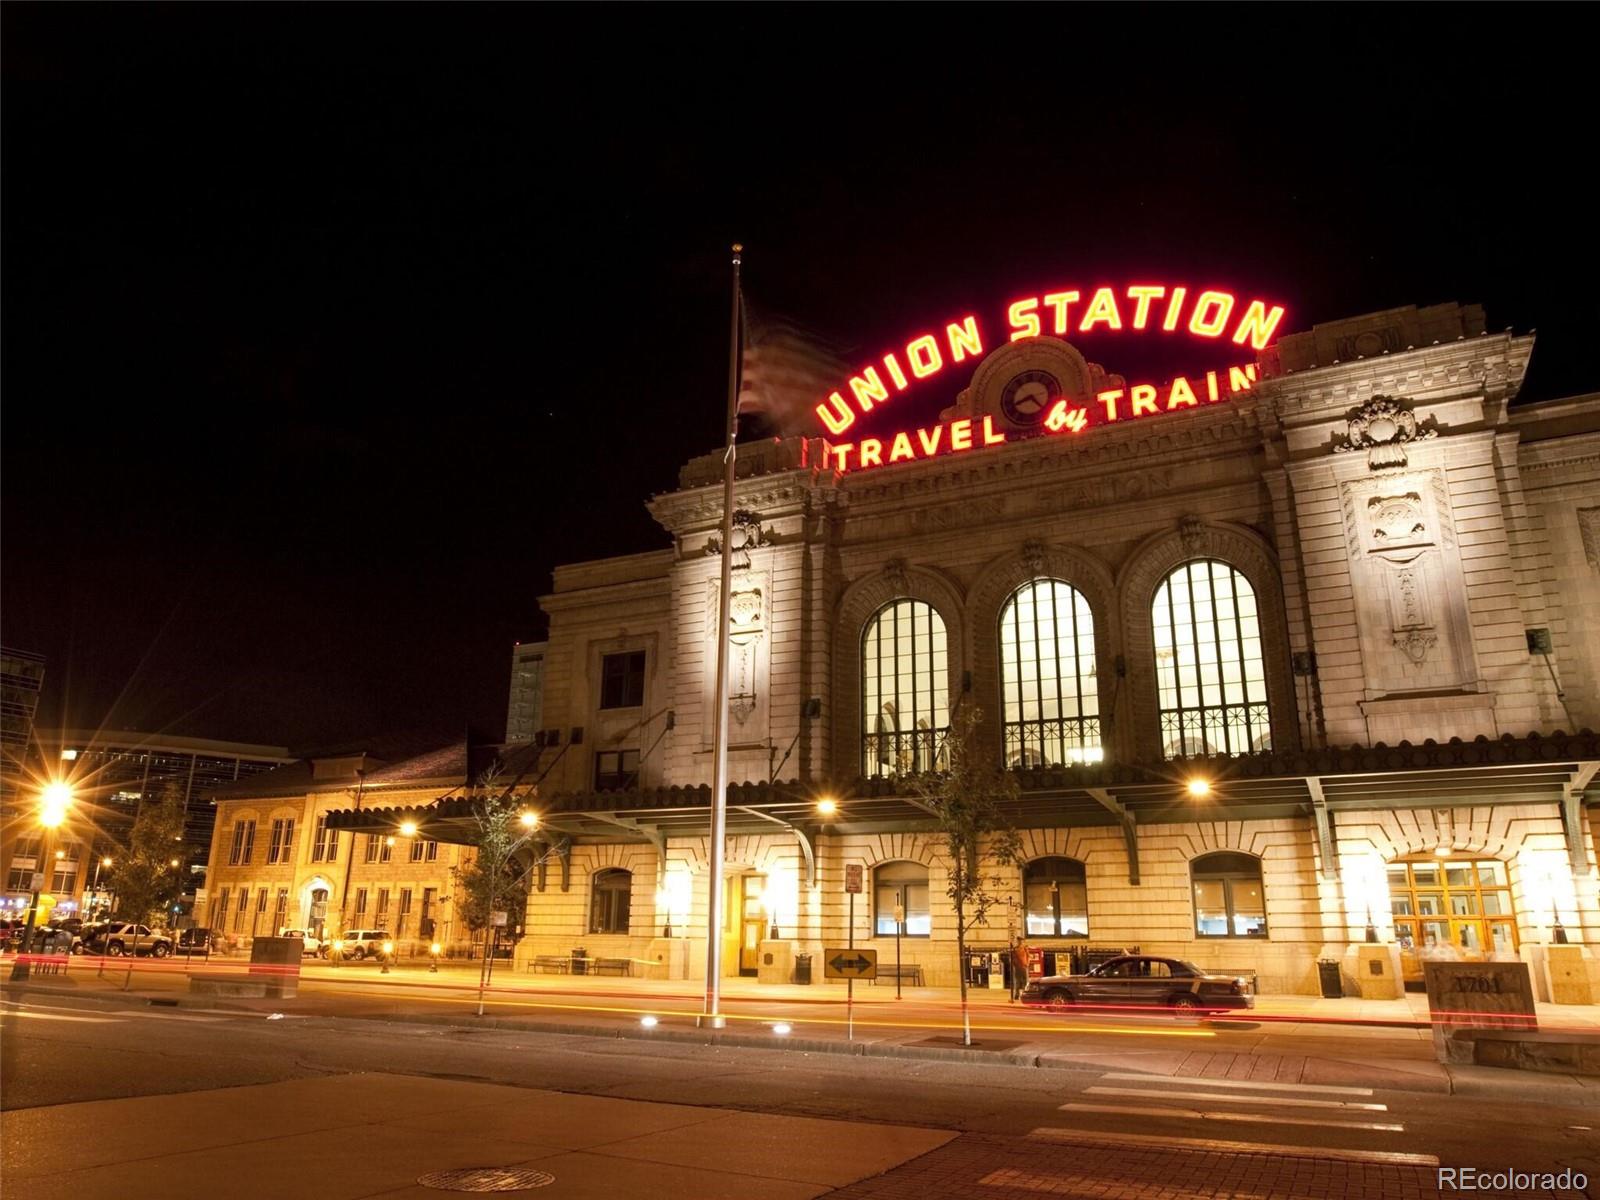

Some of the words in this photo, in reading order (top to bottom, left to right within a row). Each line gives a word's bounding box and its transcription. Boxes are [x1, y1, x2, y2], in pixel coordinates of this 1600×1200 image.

[815, 315, 984, 435] UNION
[1007, 285, 1285, 350] STATION
[831, 415, 1005, 472] TRAVEL
[1044, 399, 1088, 433] by
[1097, 363, 1258, 422] TRAIN
[907, 499, 1003, 531] UNION
[1038, 469, 1173, 508] STATION
[1455, 975, 1501, 994] 1701
